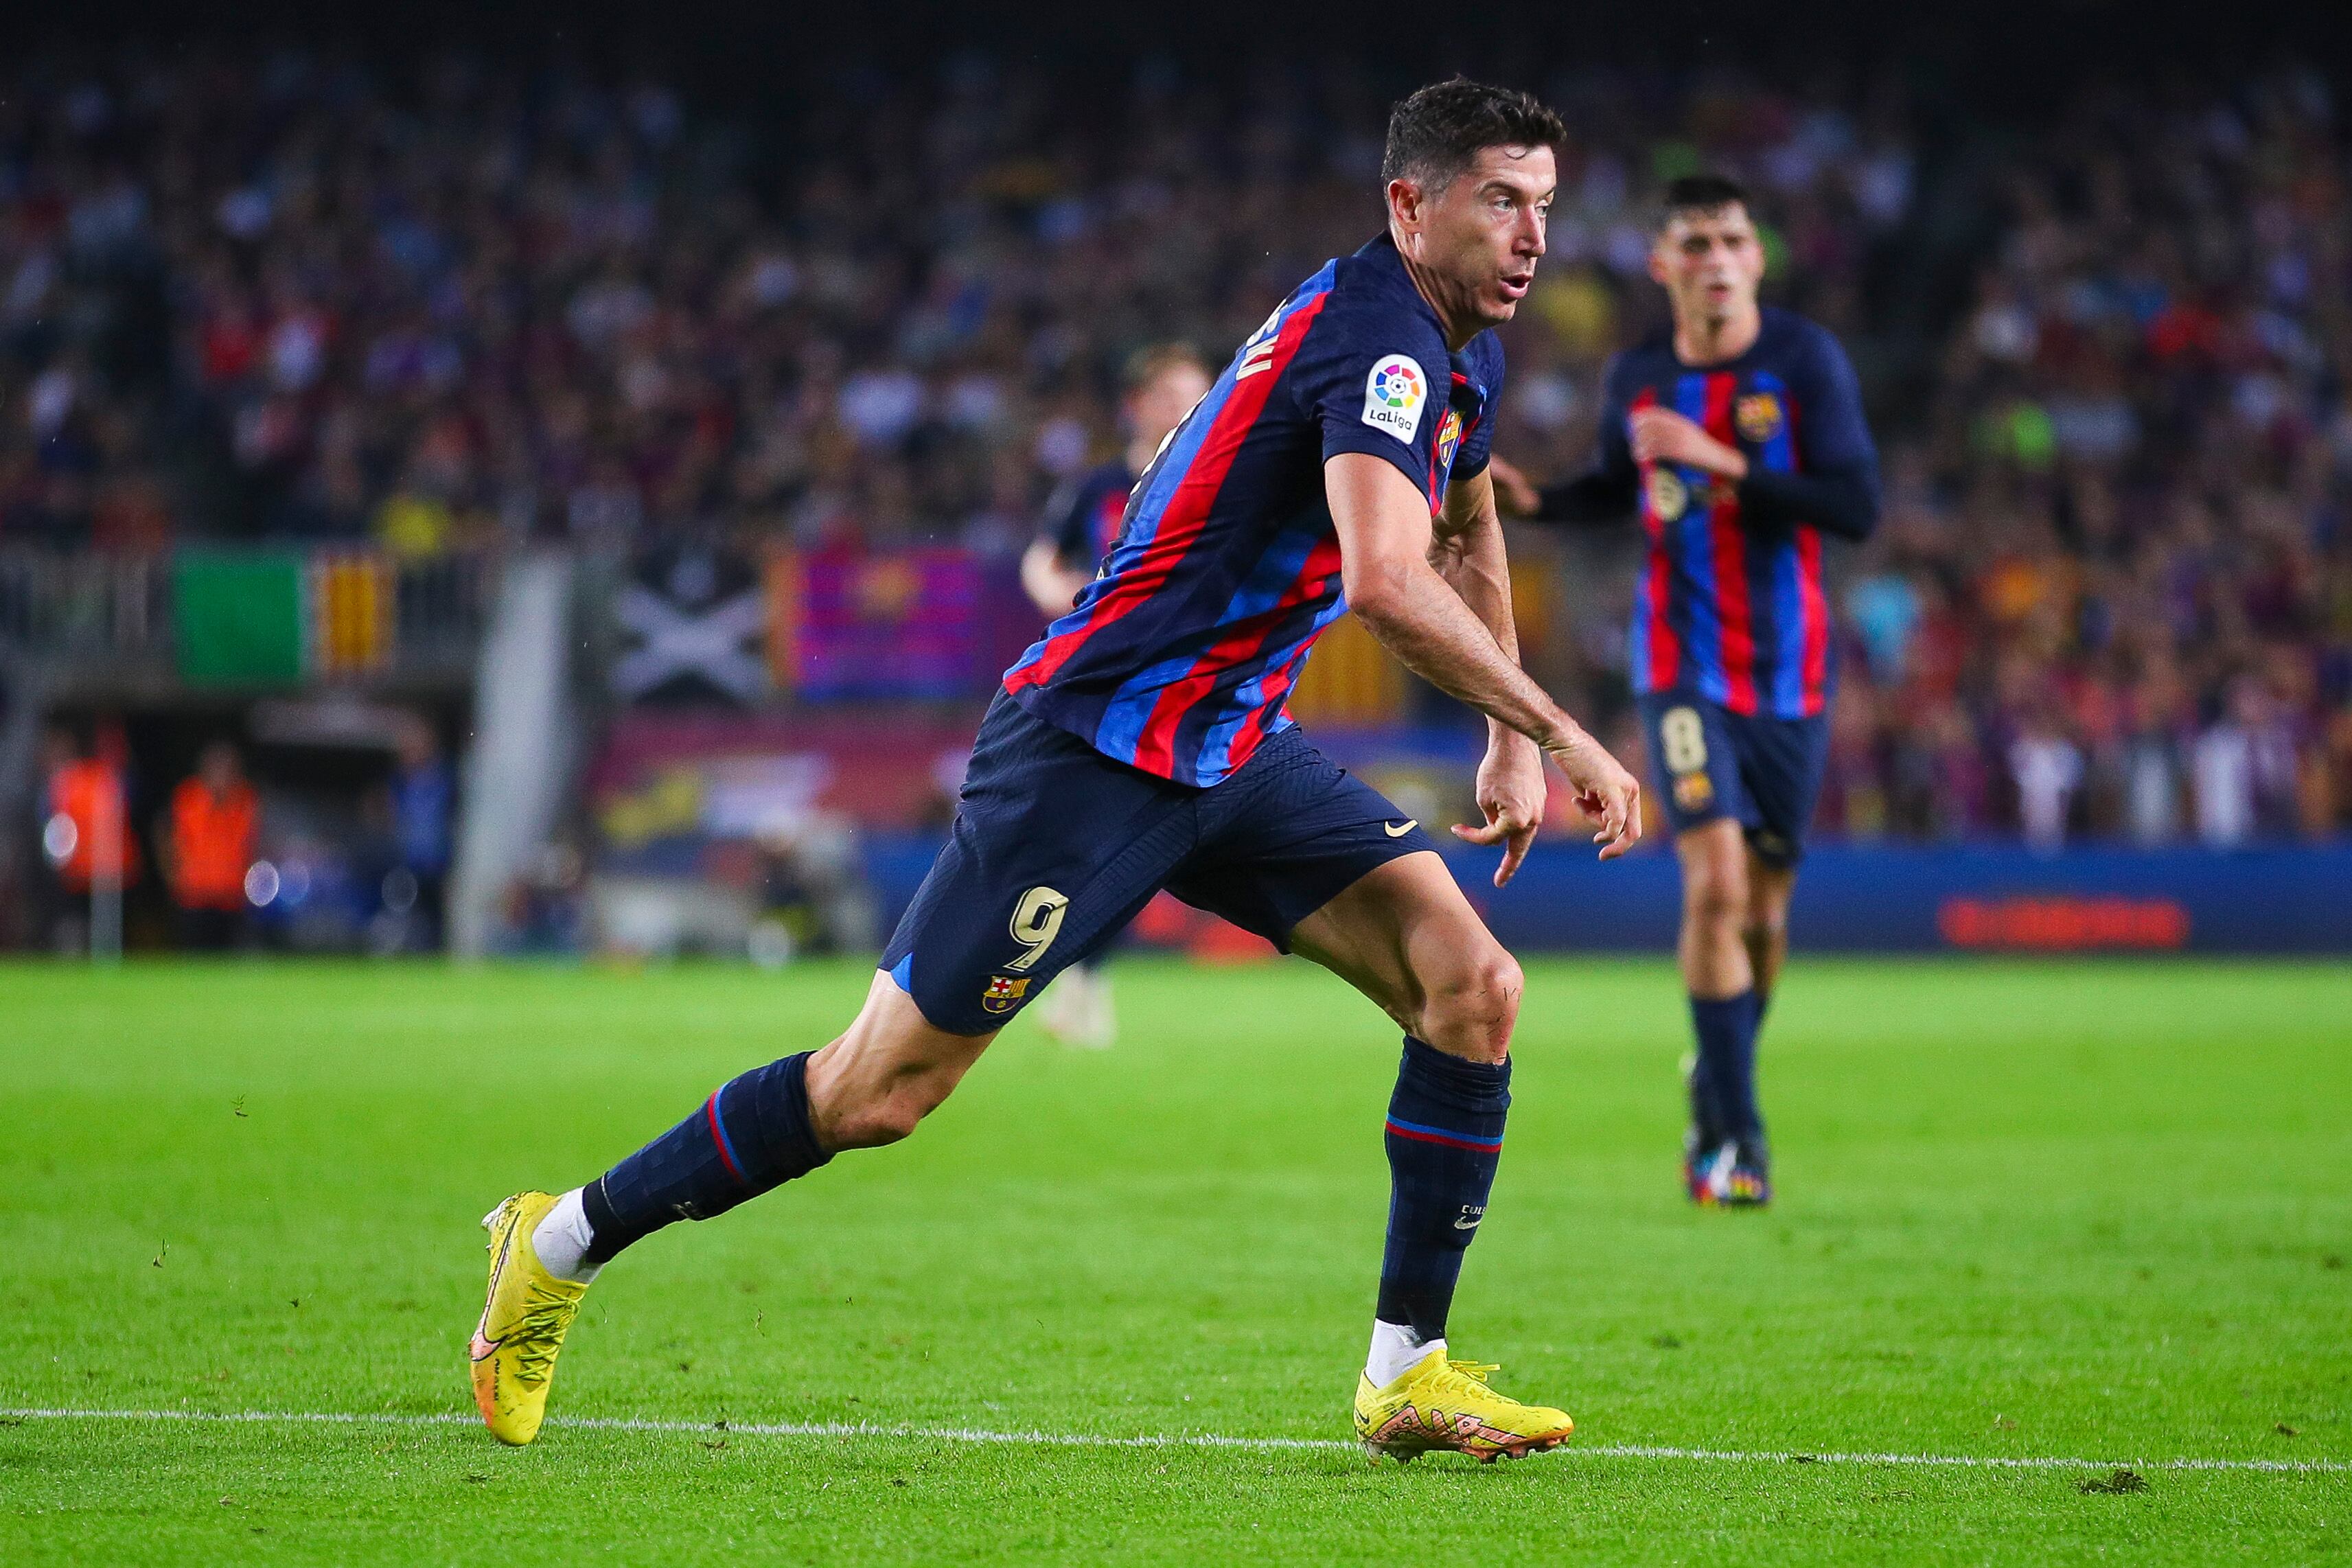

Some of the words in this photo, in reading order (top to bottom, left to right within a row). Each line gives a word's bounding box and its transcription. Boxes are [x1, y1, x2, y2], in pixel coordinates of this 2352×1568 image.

[1370, 410, 1412, 430] LaLiga
[1661, 705, 1708, 774] 8
[1002, 886, 1070, 972] 9
